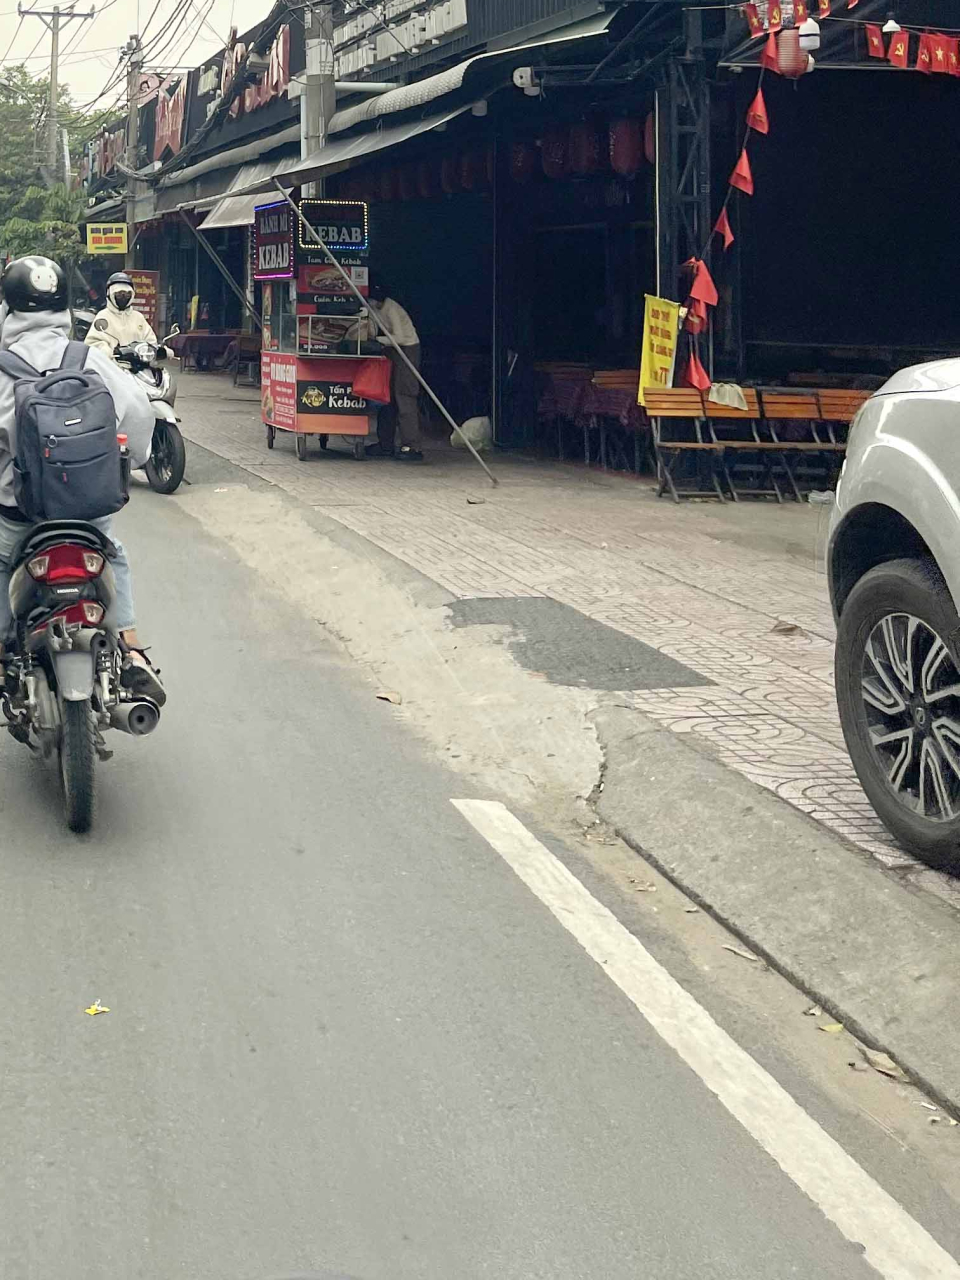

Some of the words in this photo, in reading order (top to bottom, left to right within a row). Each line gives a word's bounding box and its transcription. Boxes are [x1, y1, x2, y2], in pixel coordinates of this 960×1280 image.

[304, 226, 362, 243] KEBAB
[258, 242, 290, 270] KEBAB
[328, 395, 367, 408] Kebab
